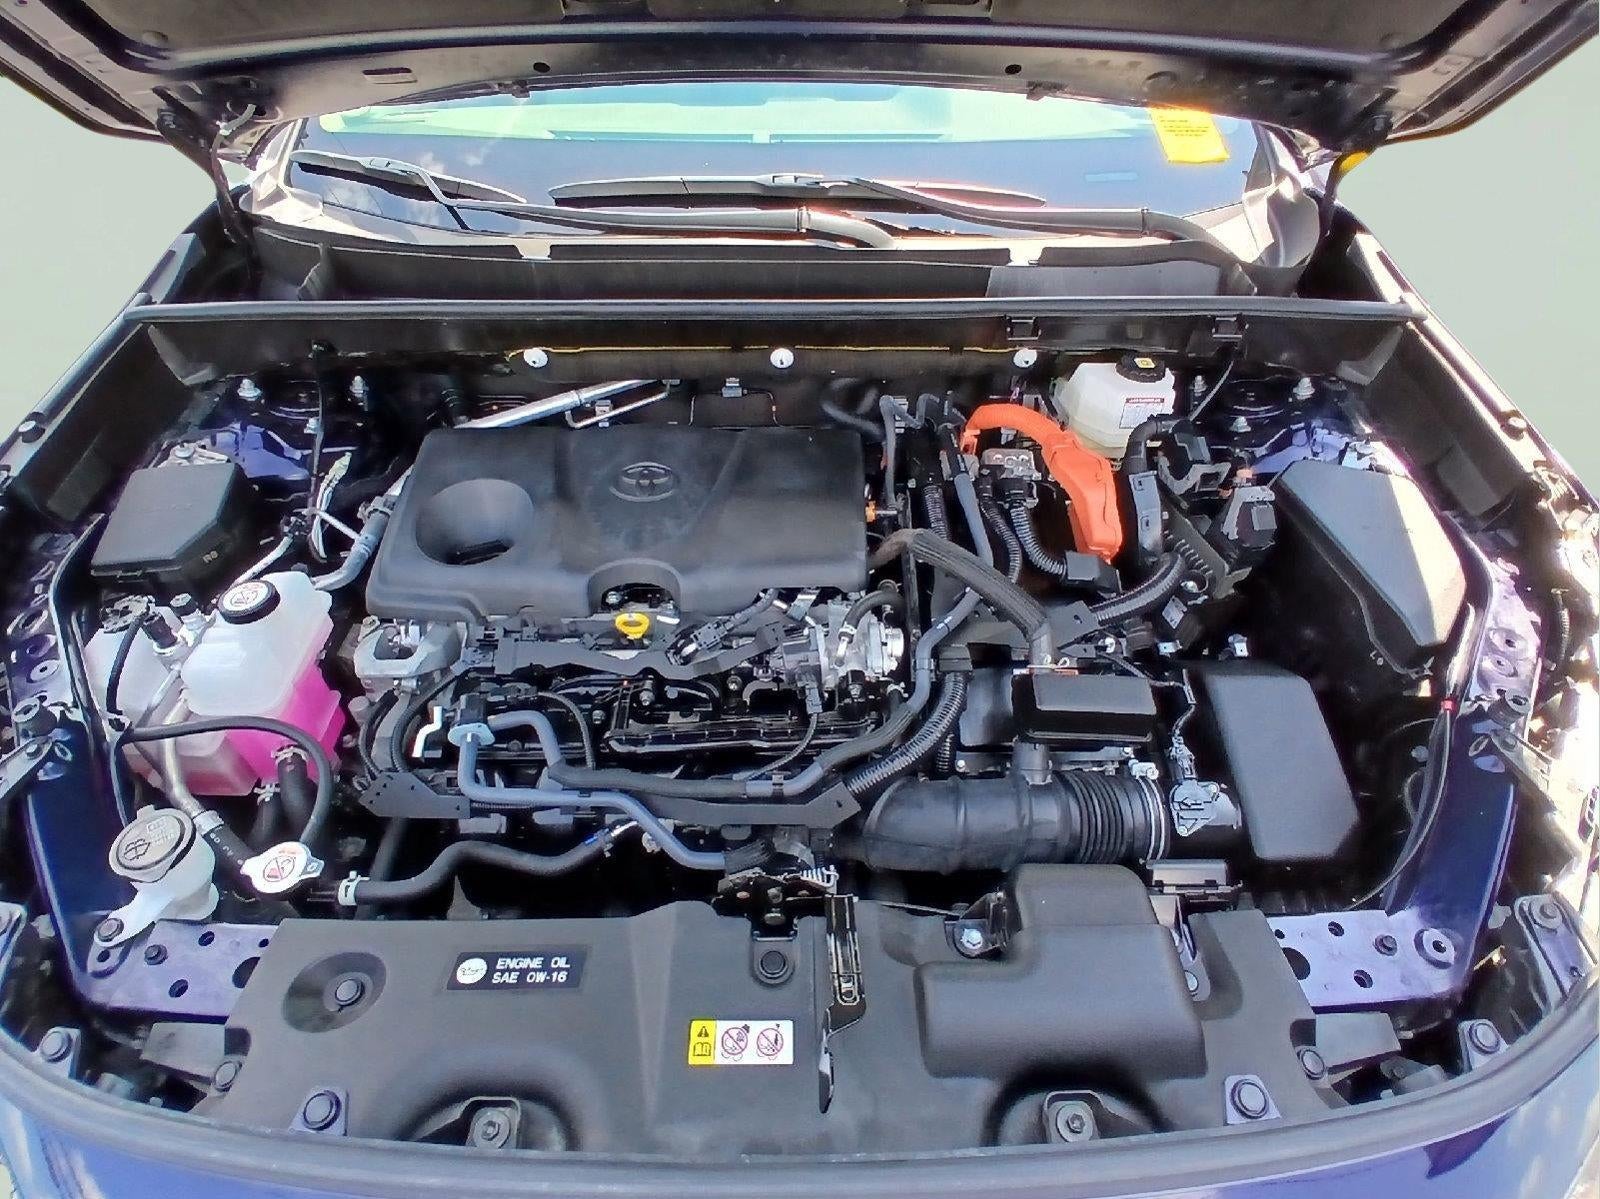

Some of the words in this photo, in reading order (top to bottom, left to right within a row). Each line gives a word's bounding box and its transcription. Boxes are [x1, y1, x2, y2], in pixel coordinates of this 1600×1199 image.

[496, 957, 544, 969] ENGINE
[551, 957, 570, 968] OIL
[492, 972, 519, 983] SAE
